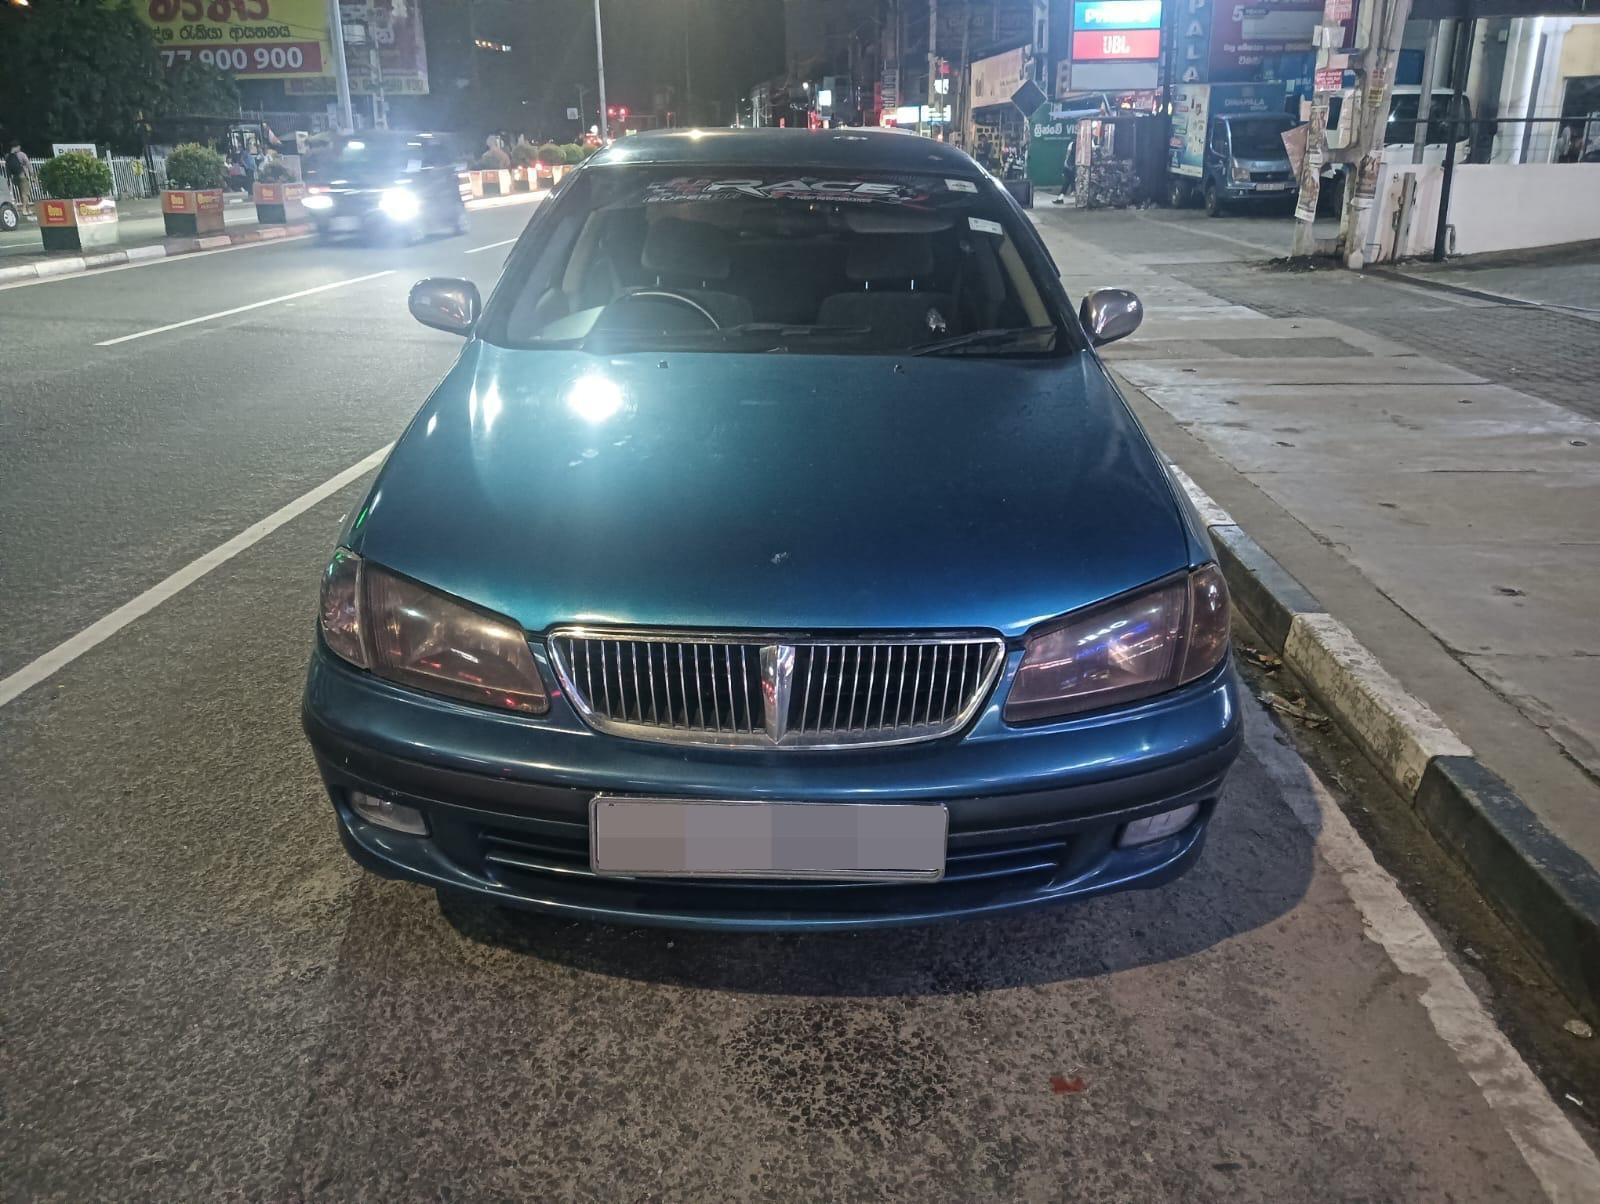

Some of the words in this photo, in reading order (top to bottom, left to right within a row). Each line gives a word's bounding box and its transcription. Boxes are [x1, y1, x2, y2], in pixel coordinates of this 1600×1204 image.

[200, 49, 248, 70] 900
[254, 47, 303, 69] 900
[703, 179, 900, 198] RACE
